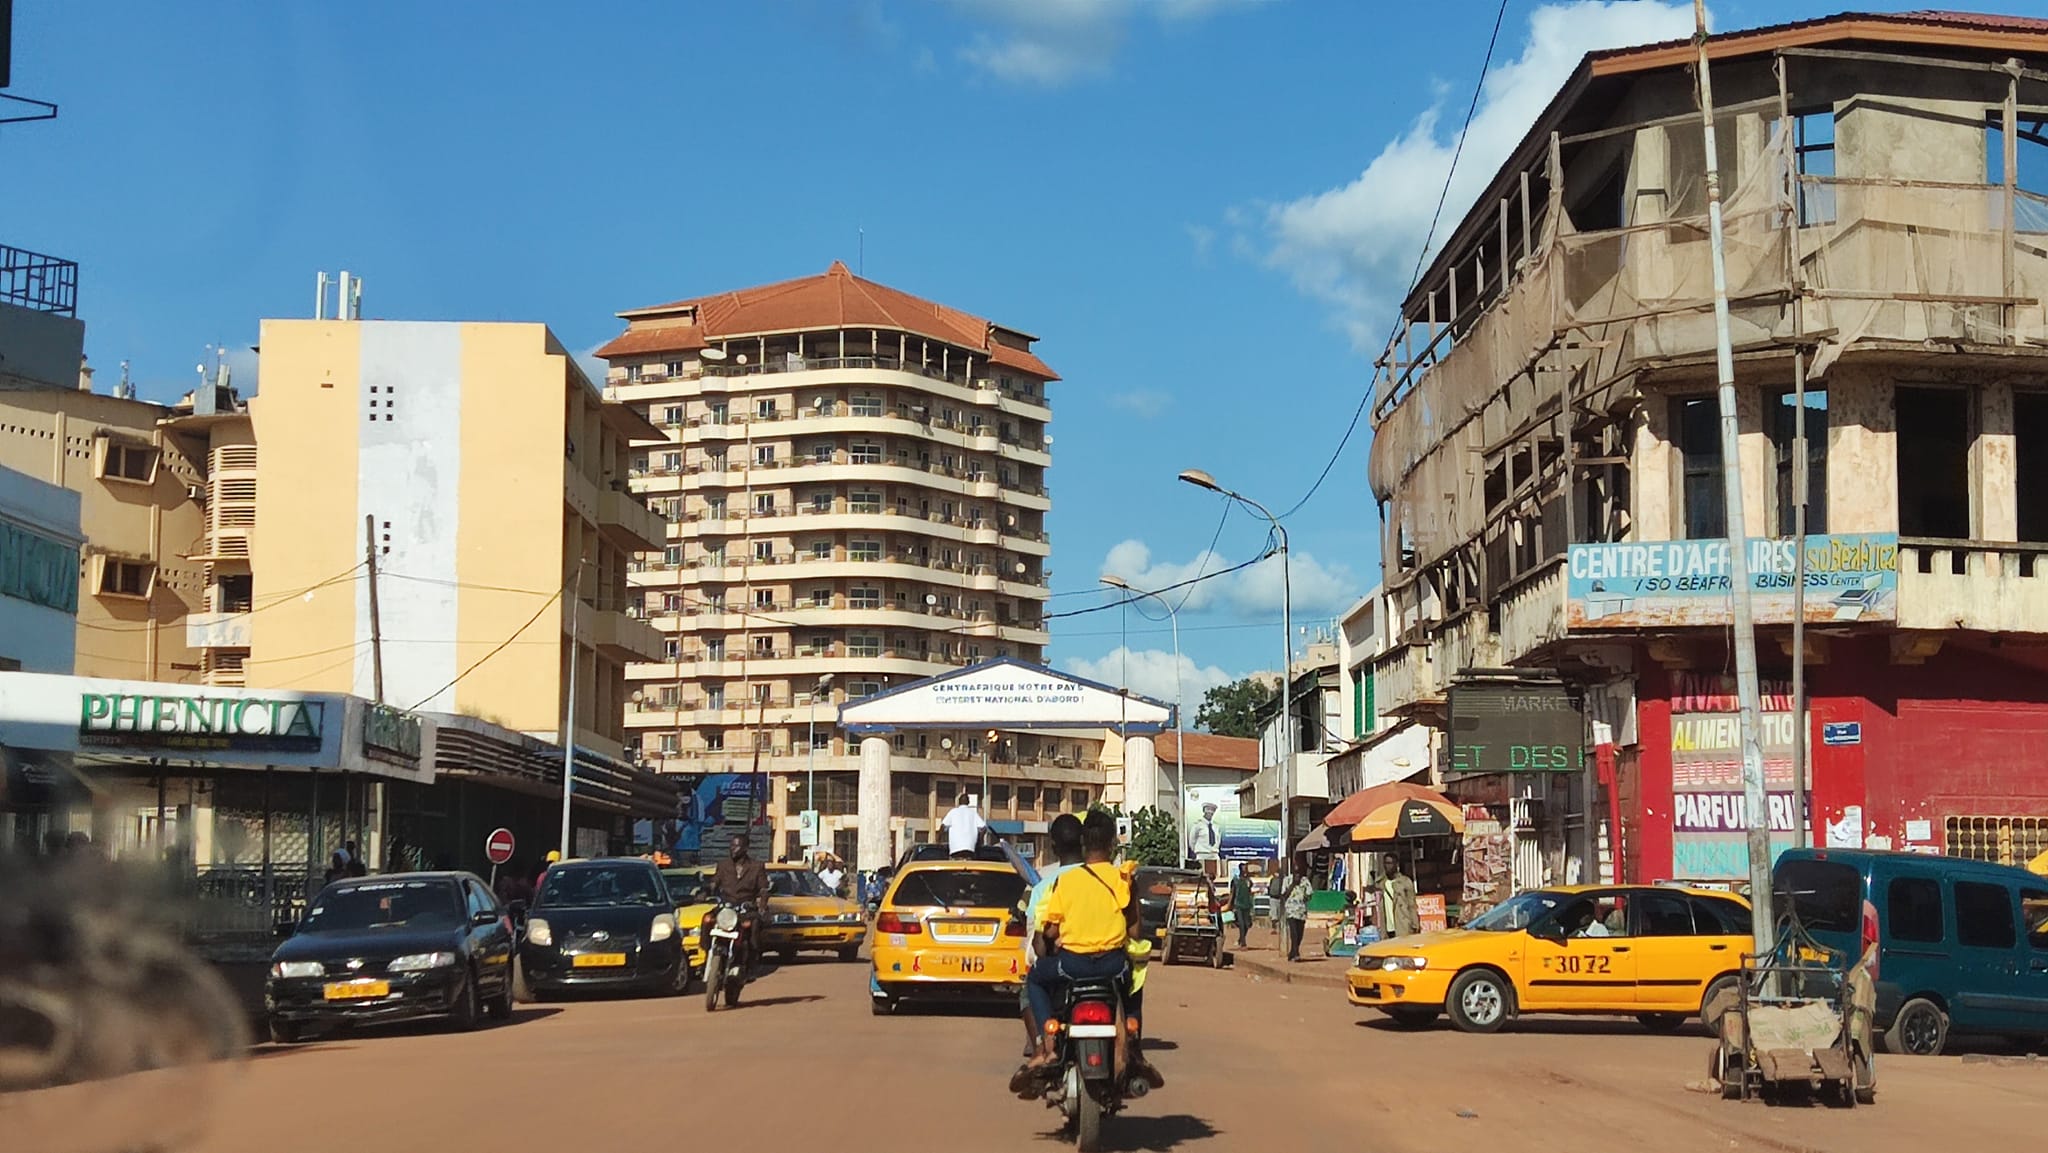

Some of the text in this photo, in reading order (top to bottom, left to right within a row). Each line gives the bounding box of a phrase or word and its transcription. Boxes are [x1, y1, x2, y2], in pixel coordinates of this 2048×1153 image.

[1572, 540, 1797, 579] CENTRE D'AFFIRES
[984, 695, 1034, 704] NATIONAL
[1036, 695, 1080, 704] D'ABORD
[1018, 683, 1053, 691] NOTRE
[1056, 683, 1084, 692] PAYS
[82, 693, 321, 737] PHENICIA
[1672, 713, 1812, 751] ALIMENTIO
[1510, 745, 1569, 768] DES
[1673, 758, 1811, 786] BOUCRI
[1674, 793, 1811, 831] PARFURI
[1555, 955, 1611, 973] 3072
